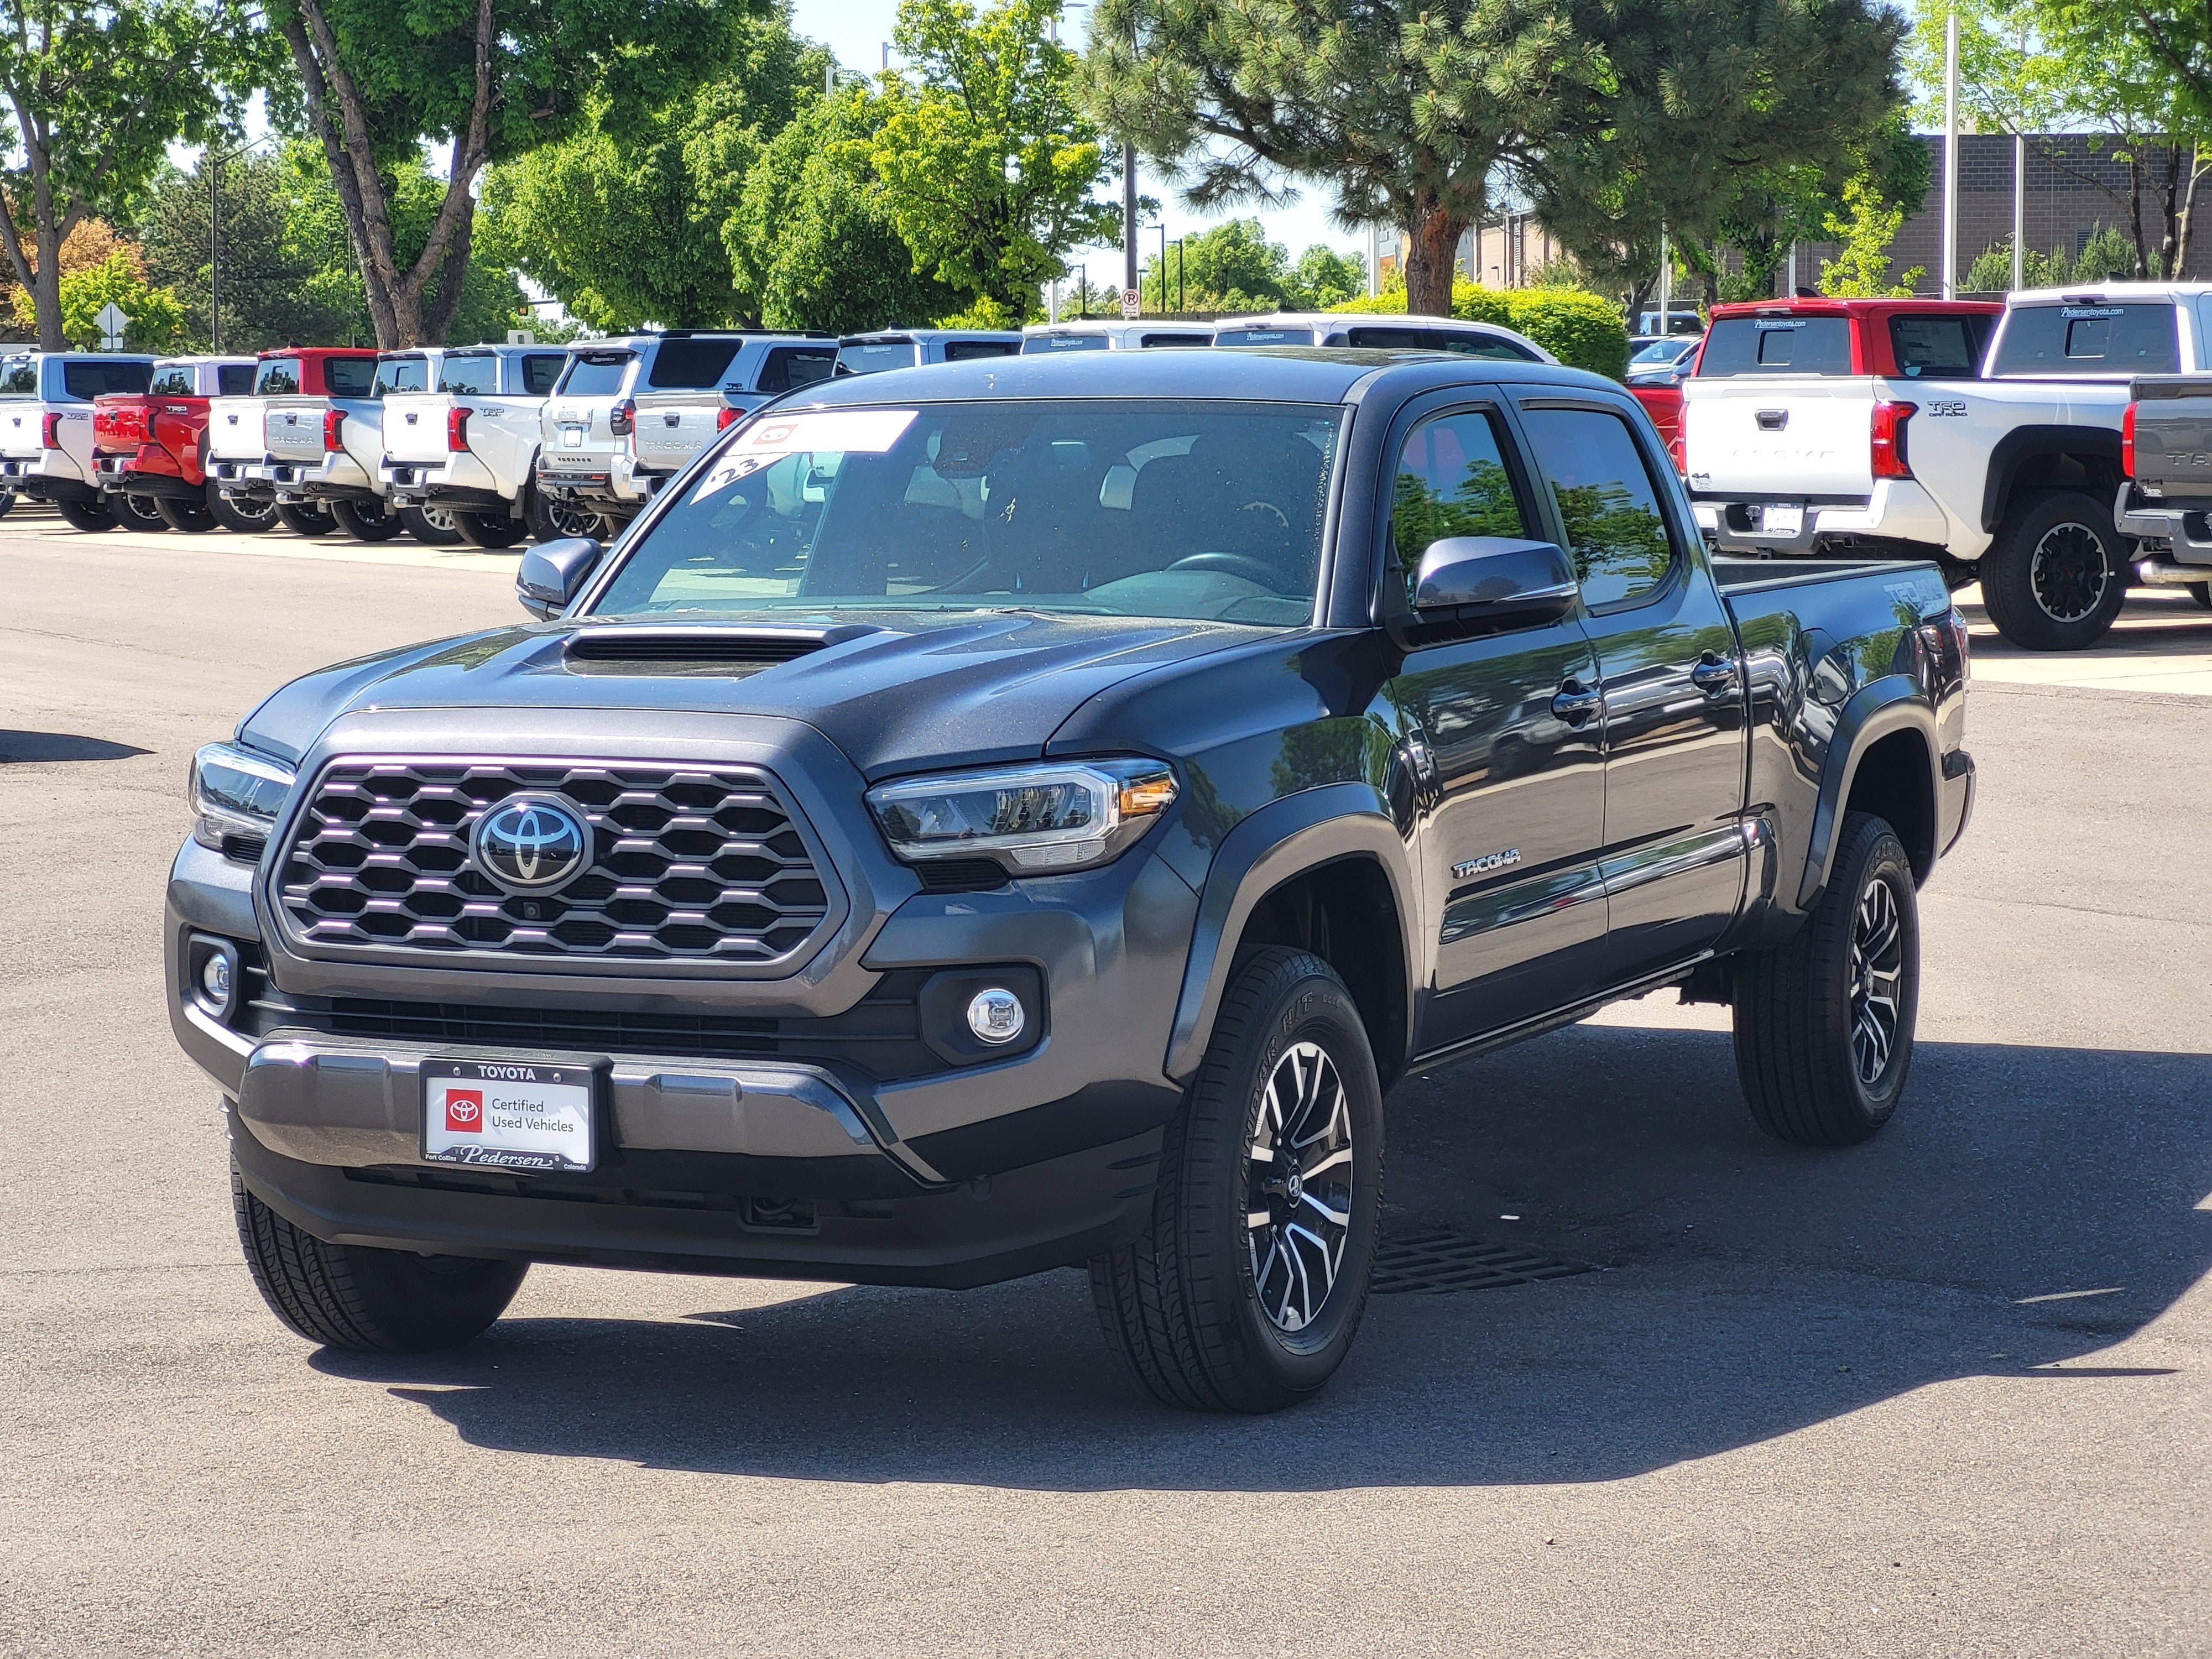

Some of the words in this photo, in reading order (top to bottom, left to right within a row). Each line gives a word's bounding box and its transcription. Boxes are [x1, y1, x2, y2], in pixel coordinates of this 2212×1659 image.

[2060, 307, 2124, 317] Pedersentoyota.com
[1754, 319, 1806, 328] Pedersentoyota.com
[1927, 400, 1966, 414] TRD
[1451, 848, 1522, 879] TACOMA
[477, 1065, 536, 1081] TOYOTA
[492, 1098, 544, 1113] Certified
[492, 1116, 522, 1129] Used
[525, 1118, 574, 1132] Vehicles
[460, 1145, 554, 1168] Pedersen
